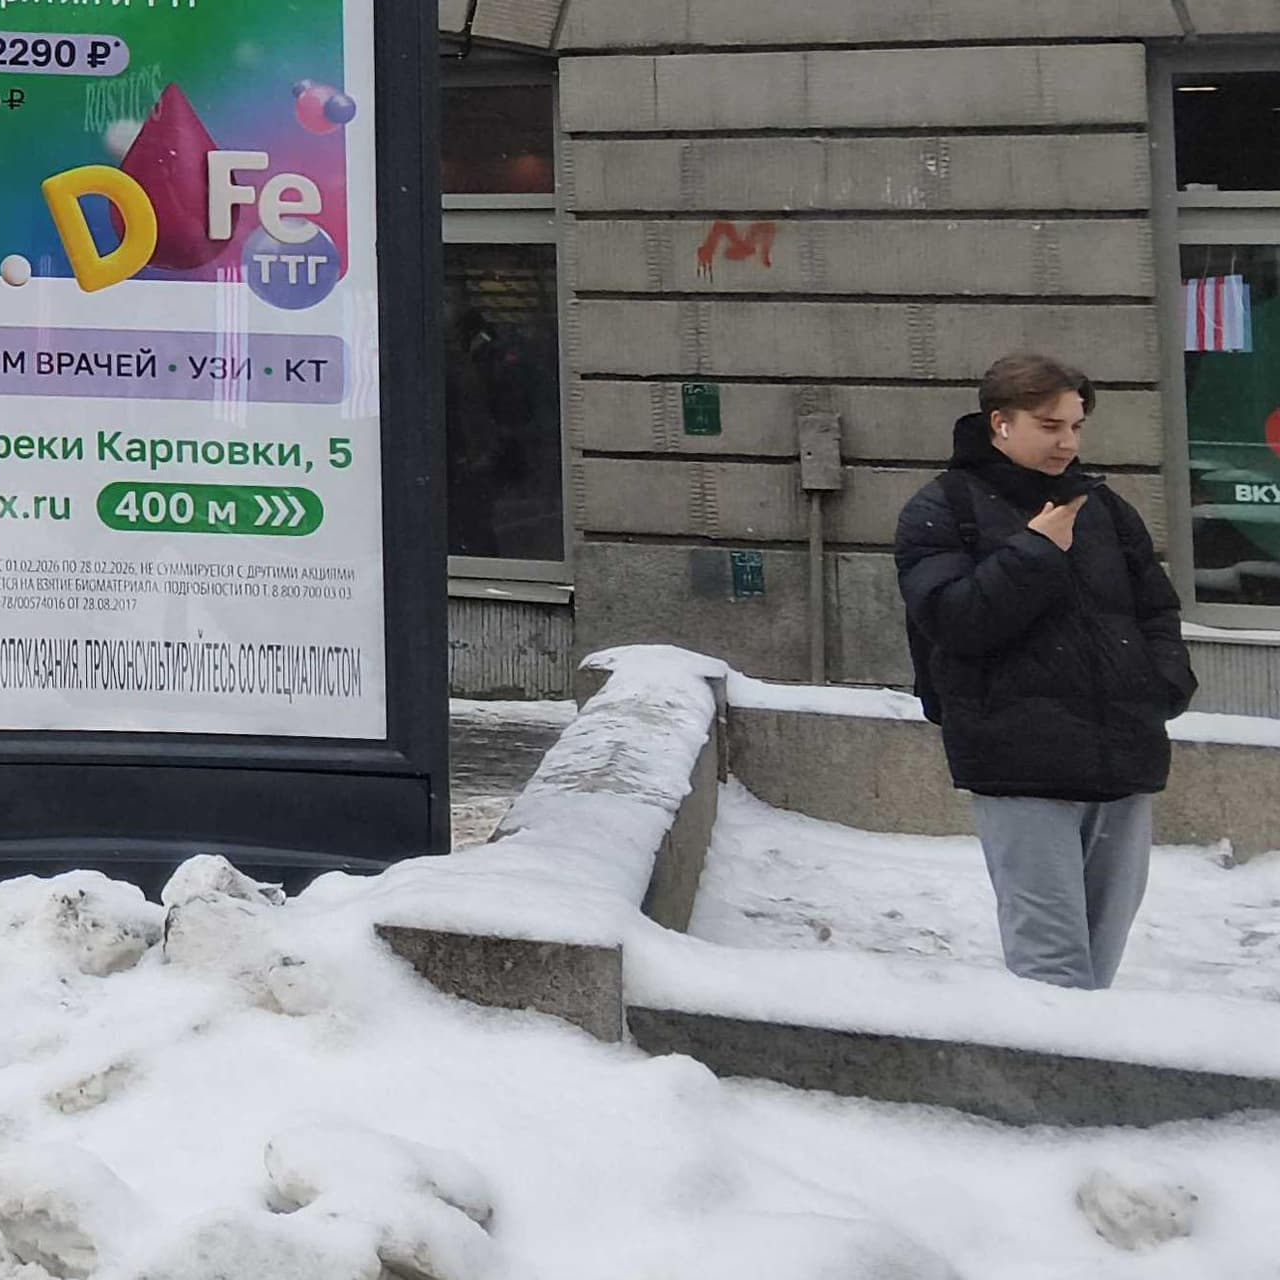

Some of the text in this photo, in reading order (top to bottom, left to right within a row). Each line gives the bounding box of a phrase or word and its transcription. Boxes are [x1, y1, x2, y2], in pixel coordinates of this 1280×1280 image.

[207, 150, 322, 244] Fe
[41, 165, 158, 294] D
[252, 254, 328, 286] ТТГ
[37, 348, 157, 378] ВРАЧЕЙ
[188, 355, 251, 381] УЗИ
[285, 359, 328, 383] КТ
[97, 430, 313, 474] Карповки,
[328, 437, 353, 470] 5
[114, 490, 237, 526] 400 м
[85, 628, 235, 692] ПРОКОНСУЛЬТИРУЙТЕСЬ
[238, 643, 255, 694] СО
[258, 644, 361, 703] СПЕЦИАЛИСТОМ
